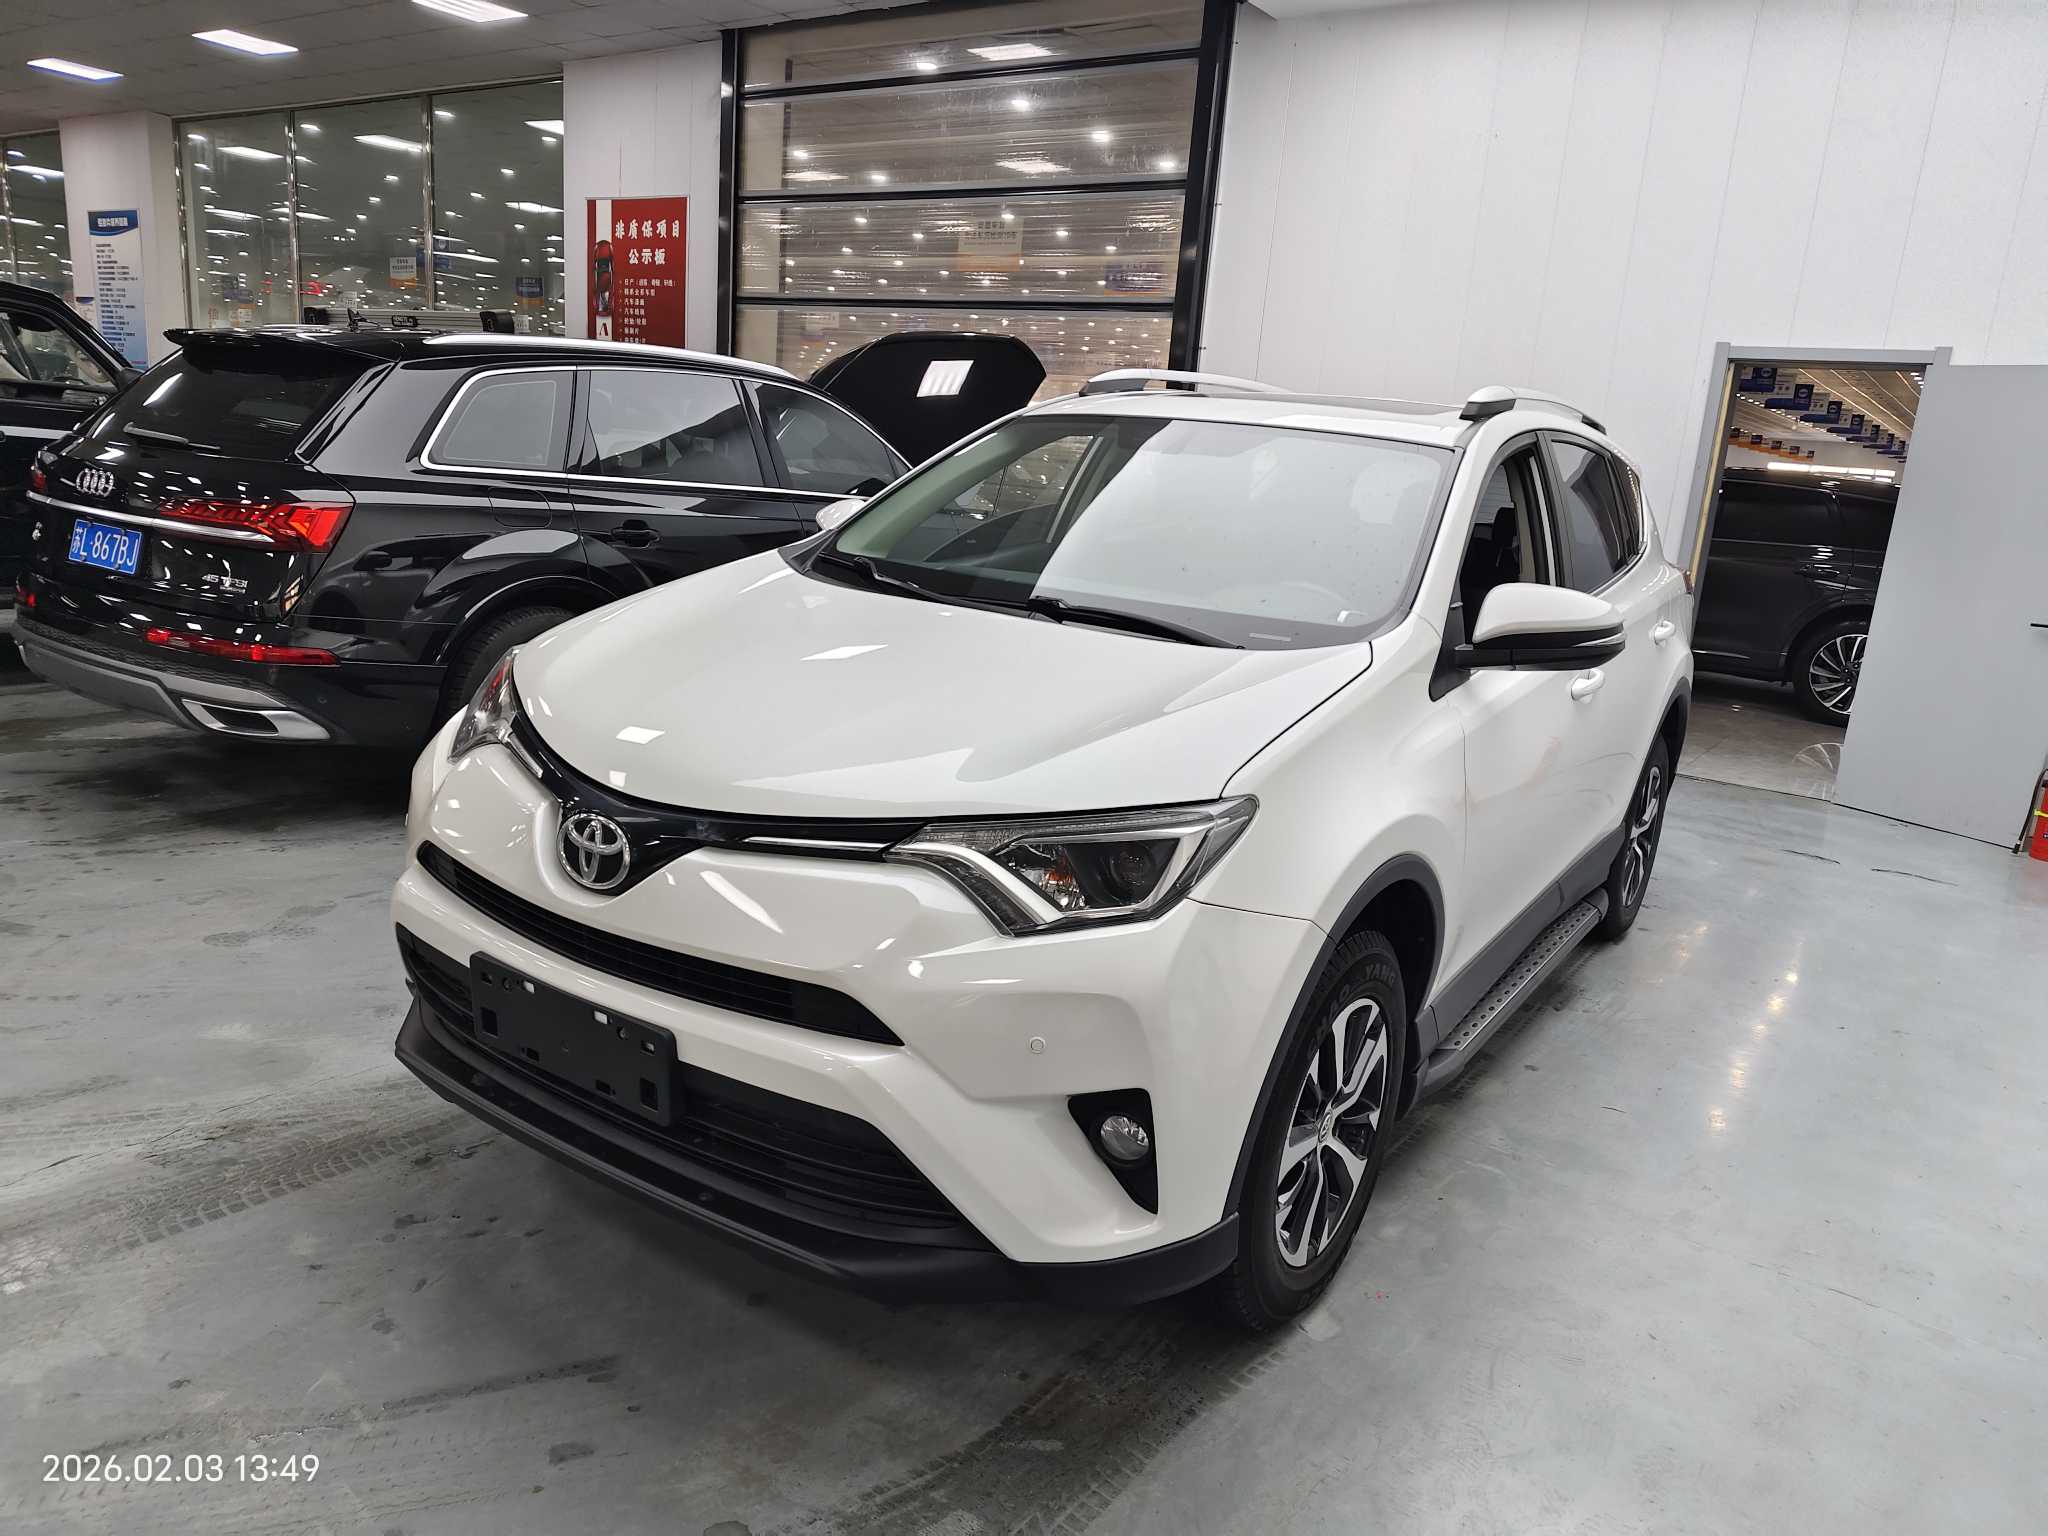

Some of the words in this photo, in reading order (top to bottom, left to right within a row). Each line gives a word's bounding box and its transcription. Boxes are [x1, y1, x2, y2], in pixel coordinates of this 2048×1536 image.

[615, 218, 681, 240] 非质保项目
[628, 248, 667, 265] 公示板
[201, 573, 219, 583] 45
